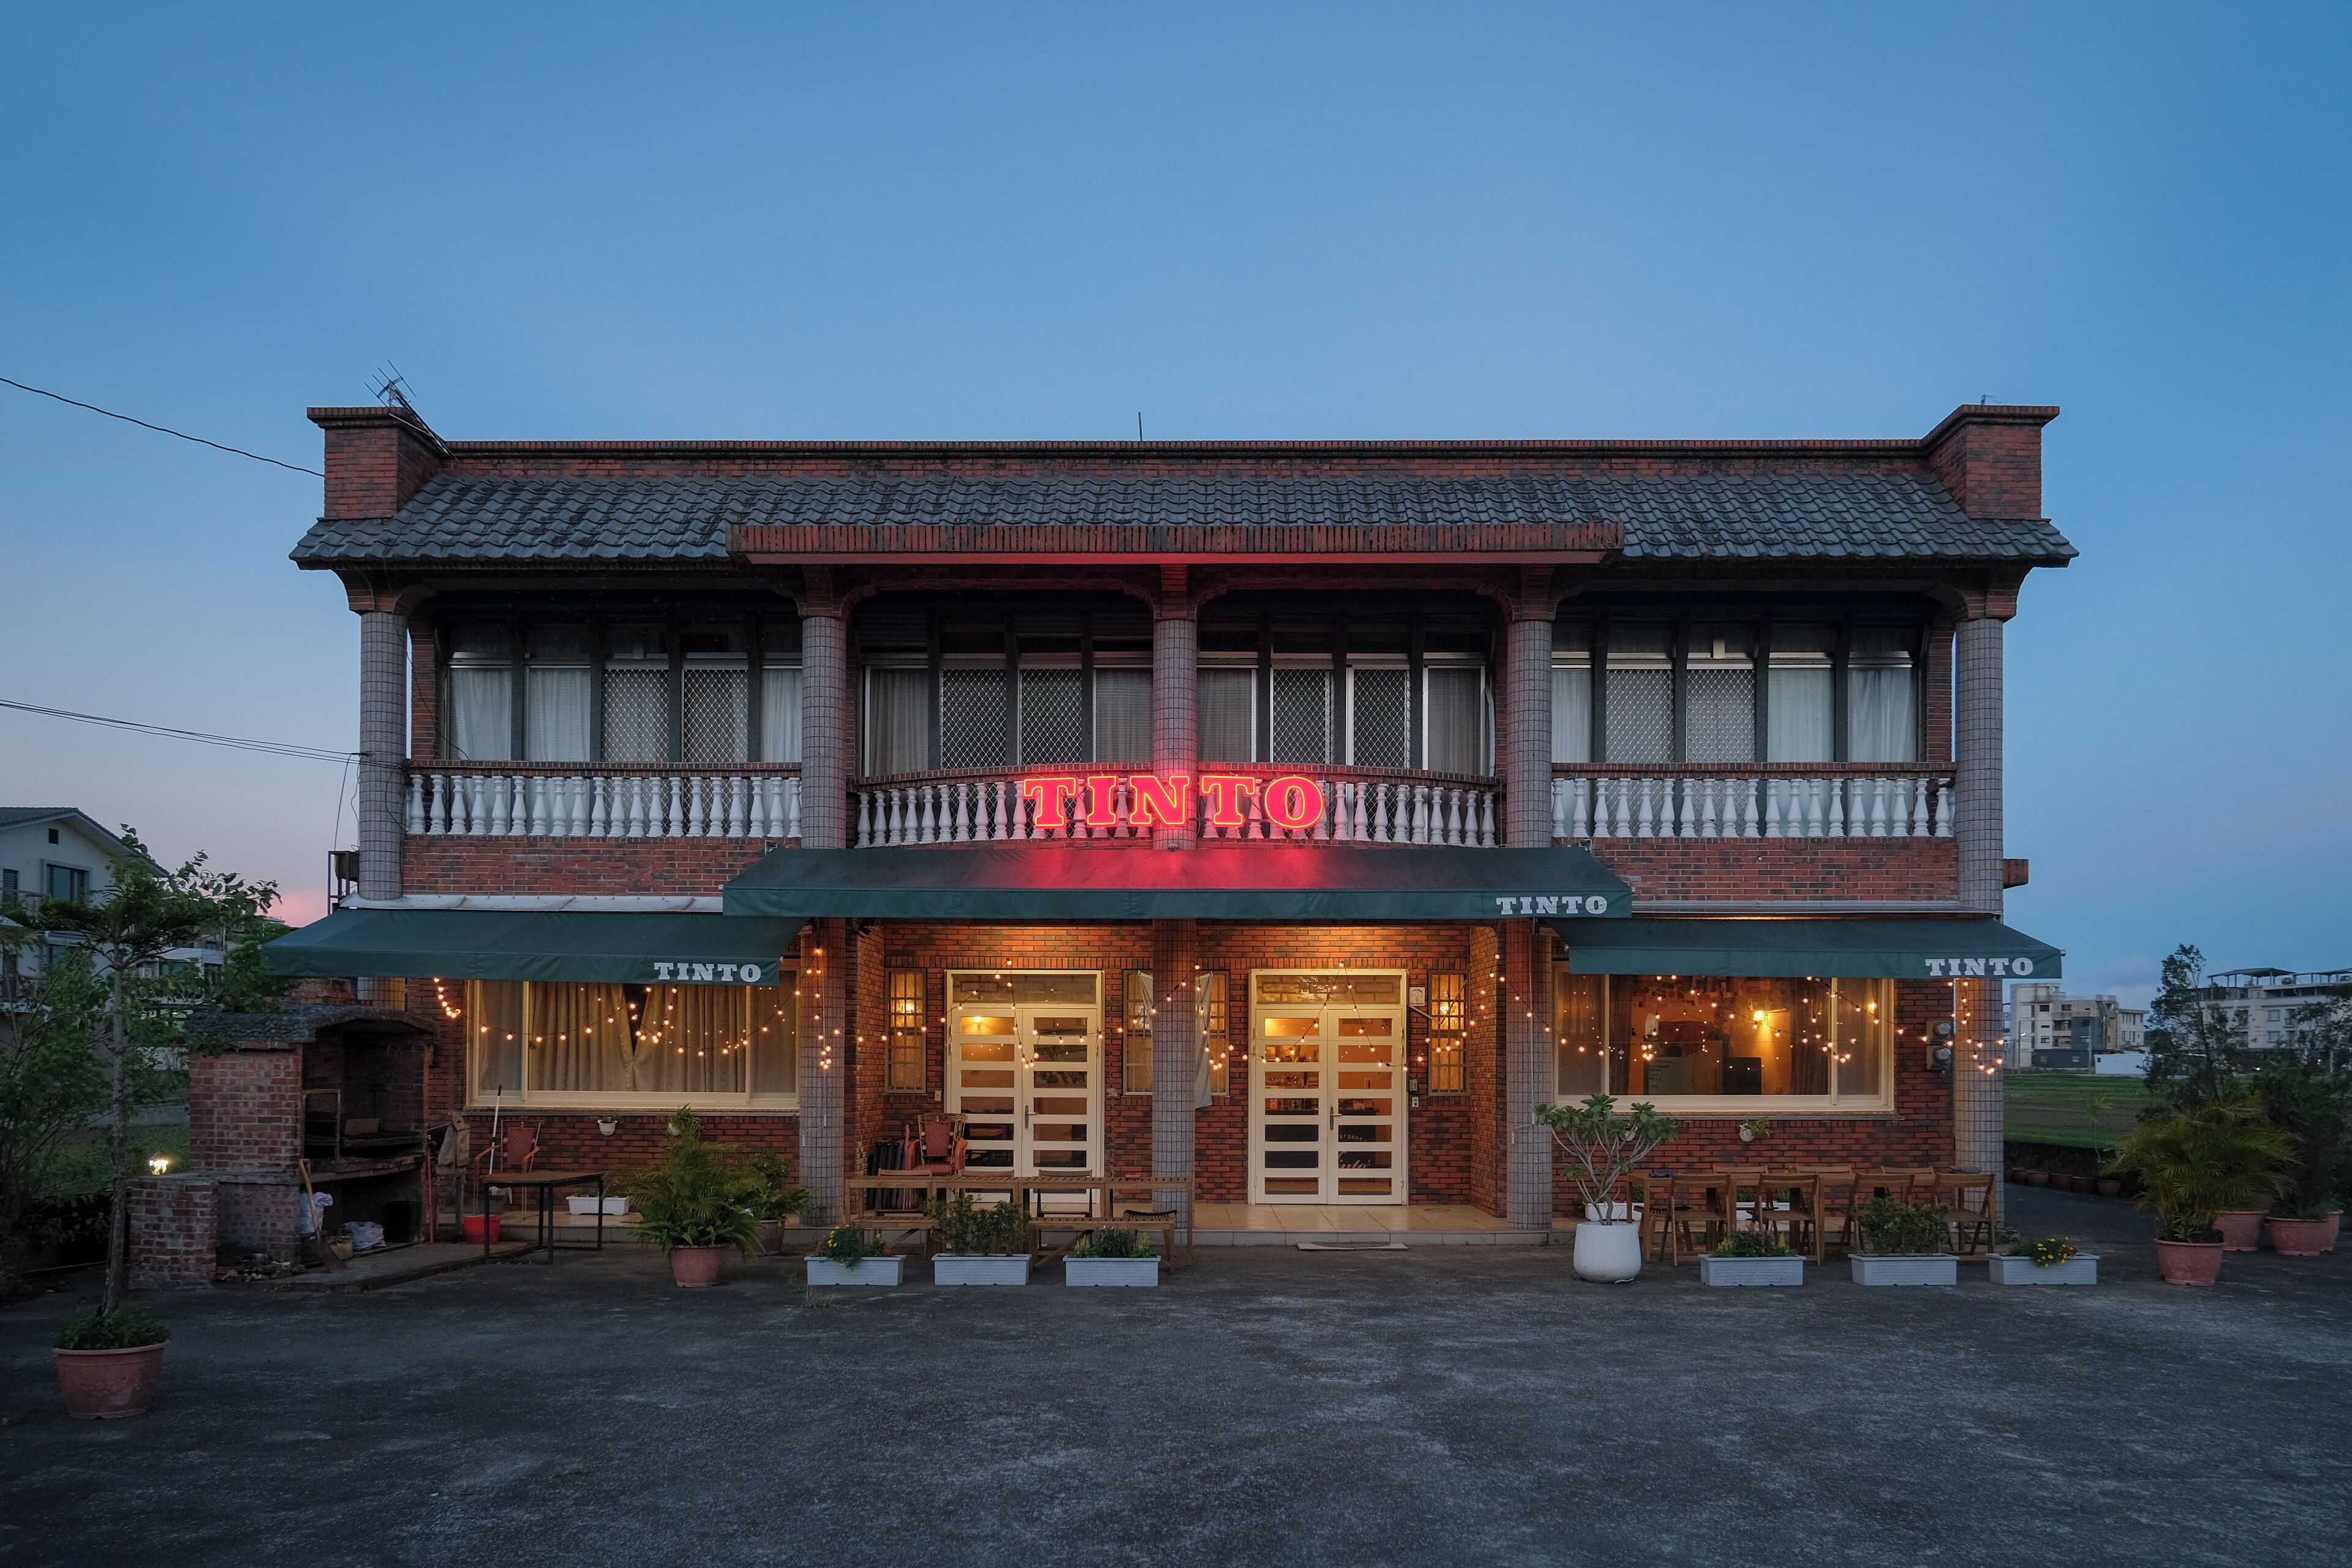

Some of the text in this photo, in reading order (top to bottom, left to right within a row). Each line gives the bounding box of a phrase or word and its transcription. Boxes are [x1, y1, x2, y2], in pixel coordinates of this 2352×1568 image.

[1022, 774, 1325, 830] TINTO
[1496, 895, 1607, 915] TINTO
[654, 962, 761, 982] TINTO
[1925, 957, 2033, 976] TINTO
